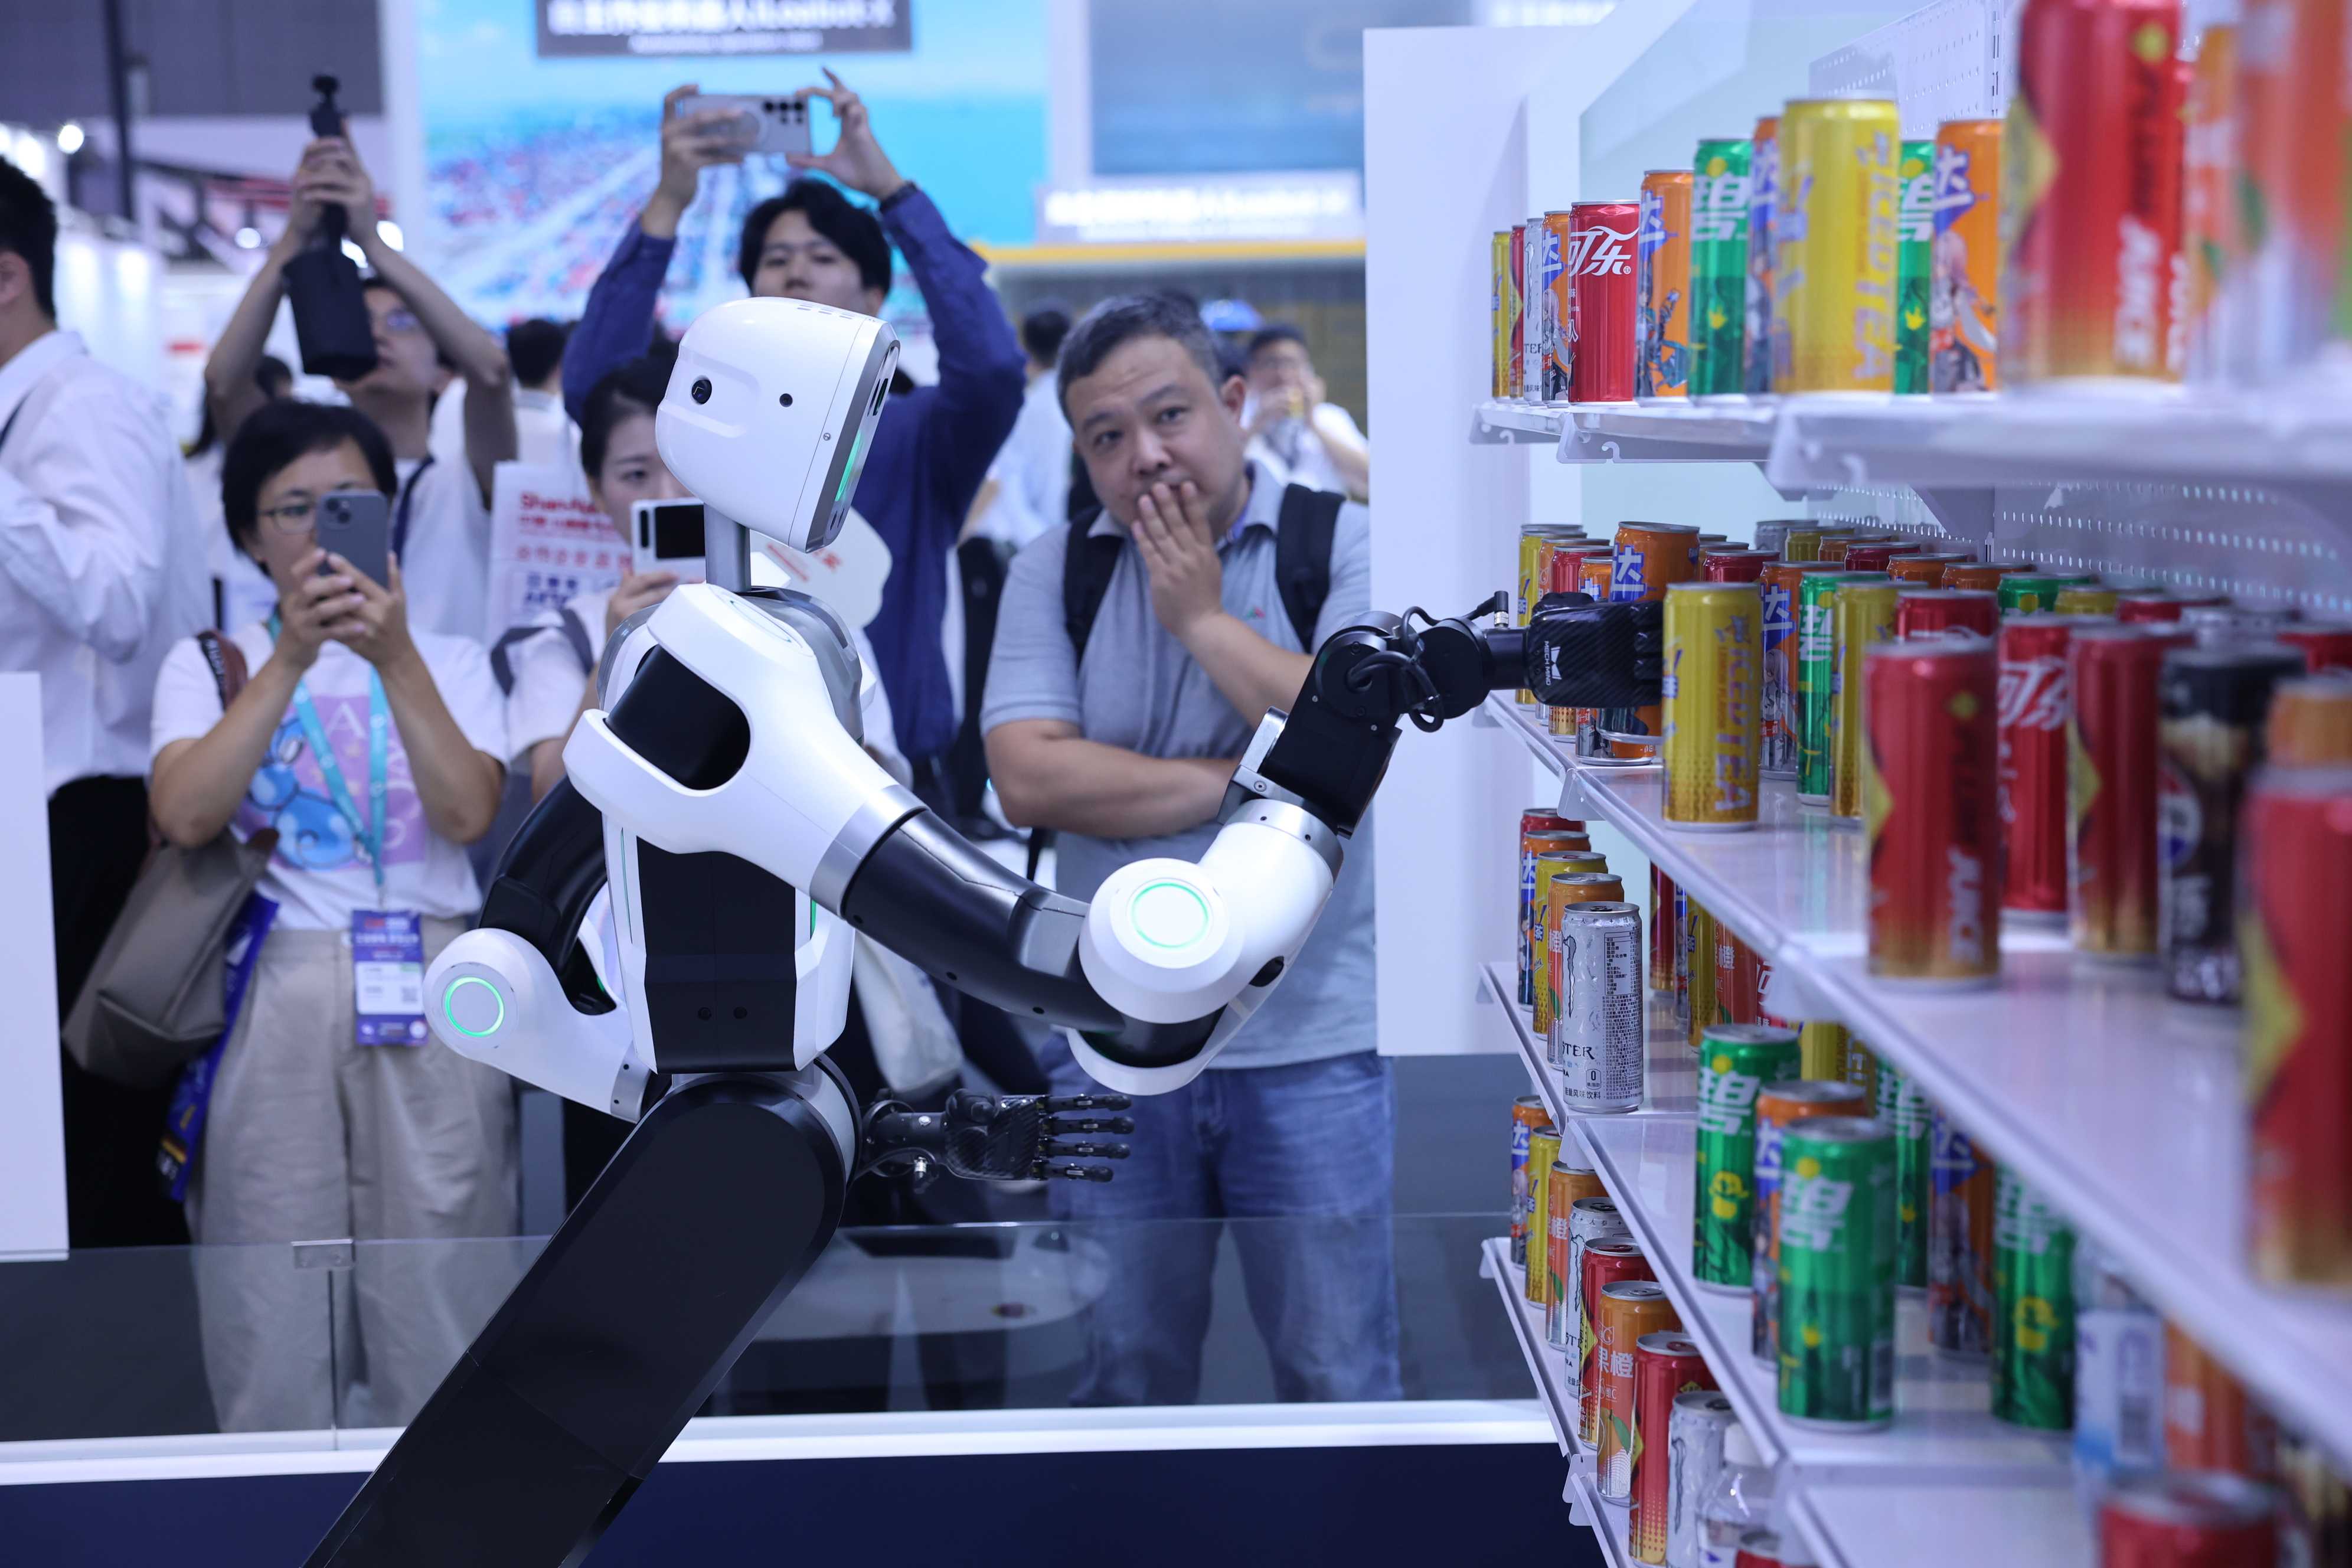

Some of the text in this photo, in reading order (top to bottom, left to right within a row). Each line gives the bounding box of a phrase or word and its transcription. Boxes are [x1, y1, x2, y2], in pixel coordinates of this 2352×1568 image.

[1693, 177, 1750, 241] 碧
[1569, 226, 1639, 277] 可乐
[1612, 544, 1644, 593] 达
[1715, 732, 1752, 812] TEA
[1698, 1067, 1760, 1135] 碧
[1779, 1170, 1853, 1250] 碧
